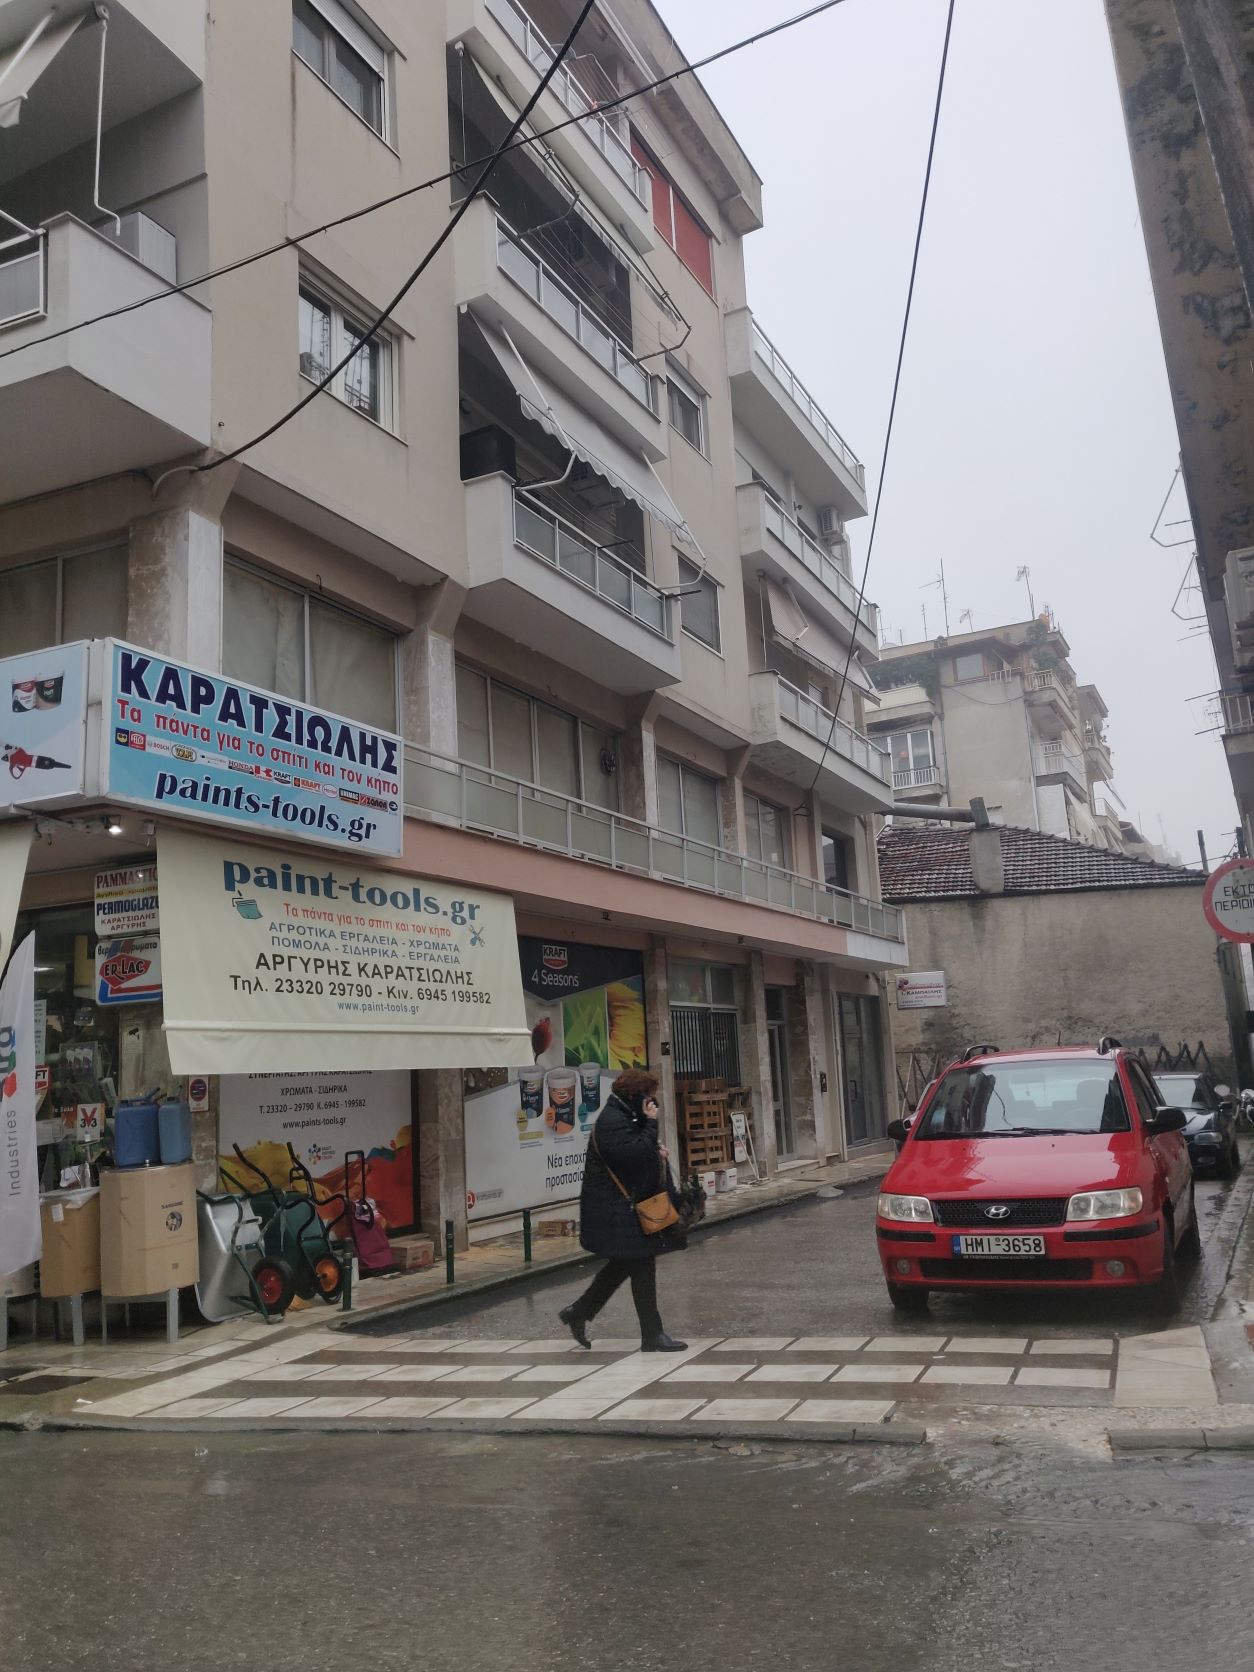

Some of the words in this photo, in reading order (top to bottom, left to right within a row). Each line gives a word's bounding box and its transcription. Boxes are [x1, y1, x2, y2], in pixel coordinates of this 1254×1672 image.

[119, 652, 398, 774] ΚΑΡΑΤΣΙΩΛΗΣ
[117, 699, 142, 724] Τα
[155, 712, 211, 742] πάντα
[216, 731, 241, 752] για
[247, 740, 265, 757] το
[314, 760, 335, 777] και
[339, 768, 363, 785] τον
[153, 742, 170, 752] BOSCH
[228, 759, 254, 773] HONDA
[273, 771, 291, 781] KRAFT
[156, 771, 377, 843] paints-tools.gr
[223, 859, 481, 927] paint-tools.gr
[101, 912, 156, 925] ΚΑΡΑΤΣΙΩΛΗΣ
[110, 921, 147, 931] ΑΡΓΥΡΗΣ
[283, 903, 299, 917] Τα
[301, 907, 334, 922] πάντα
[337, 914, 352, 926] για
[355, 917, 366, 926] το
[395, 922, 409, 932] και
[412, 925, 427, 934] τον
[269, 921, 337, 940] ΑΓΡΟΤΙΚΑ
[340, 931, 399, 947] ΕΡΓΑΛΕΙΑ
[408, 939, 460, 953] ΧΡΩΜΑΤΑ
[271, 935, 331, 953] ΠΟΜΟΛΑ
[342, 944, 399, 959] ΣΙΔΗΡΙΚΑ
[408, 951, 461, 965] ΕΡΓΑΛΕΙΑ
[543, 946, 567, 958] KRAFT
[255, 952, 352, 977] ΑΡΓΥΡΗΣ
[357, 962, 474, 986] ΚΑΡΑΤΣΙΩΛΗΣ
[531, 969, 539, 985] 4
[541, 969, 580, 987] Seasons
[229, 974, 268, 995] Τηλ.
[274, 977, 324, 995] 23320
[328, 981, 373, 998] 29790
[386, 985, 413, 1000] Κιν.
[417, 987, 448, 1002] 6945
[451, 990, 492, 1005] 199582
[337, 1001, 420, 1016] www.paint-tools.gr
[280, 1086, 313, 1096] ΧΡΩΜΑΤΑ
[318, 1084, 348, 1094] ΣΙΔΗΡΙΚΑ
[266, 1104, 287, 1114] 23320
[294, 1102, 314, 1112] 29790
[324, 1100, 339, 1109] 6945
[344, 1099, 366, 1108] 199582
[282, 1116, 347, 1130] www.paints-tools.gr
[9, 1110, 20, 1197] Industries
[547, 1152, 563, 1169] Νέα
